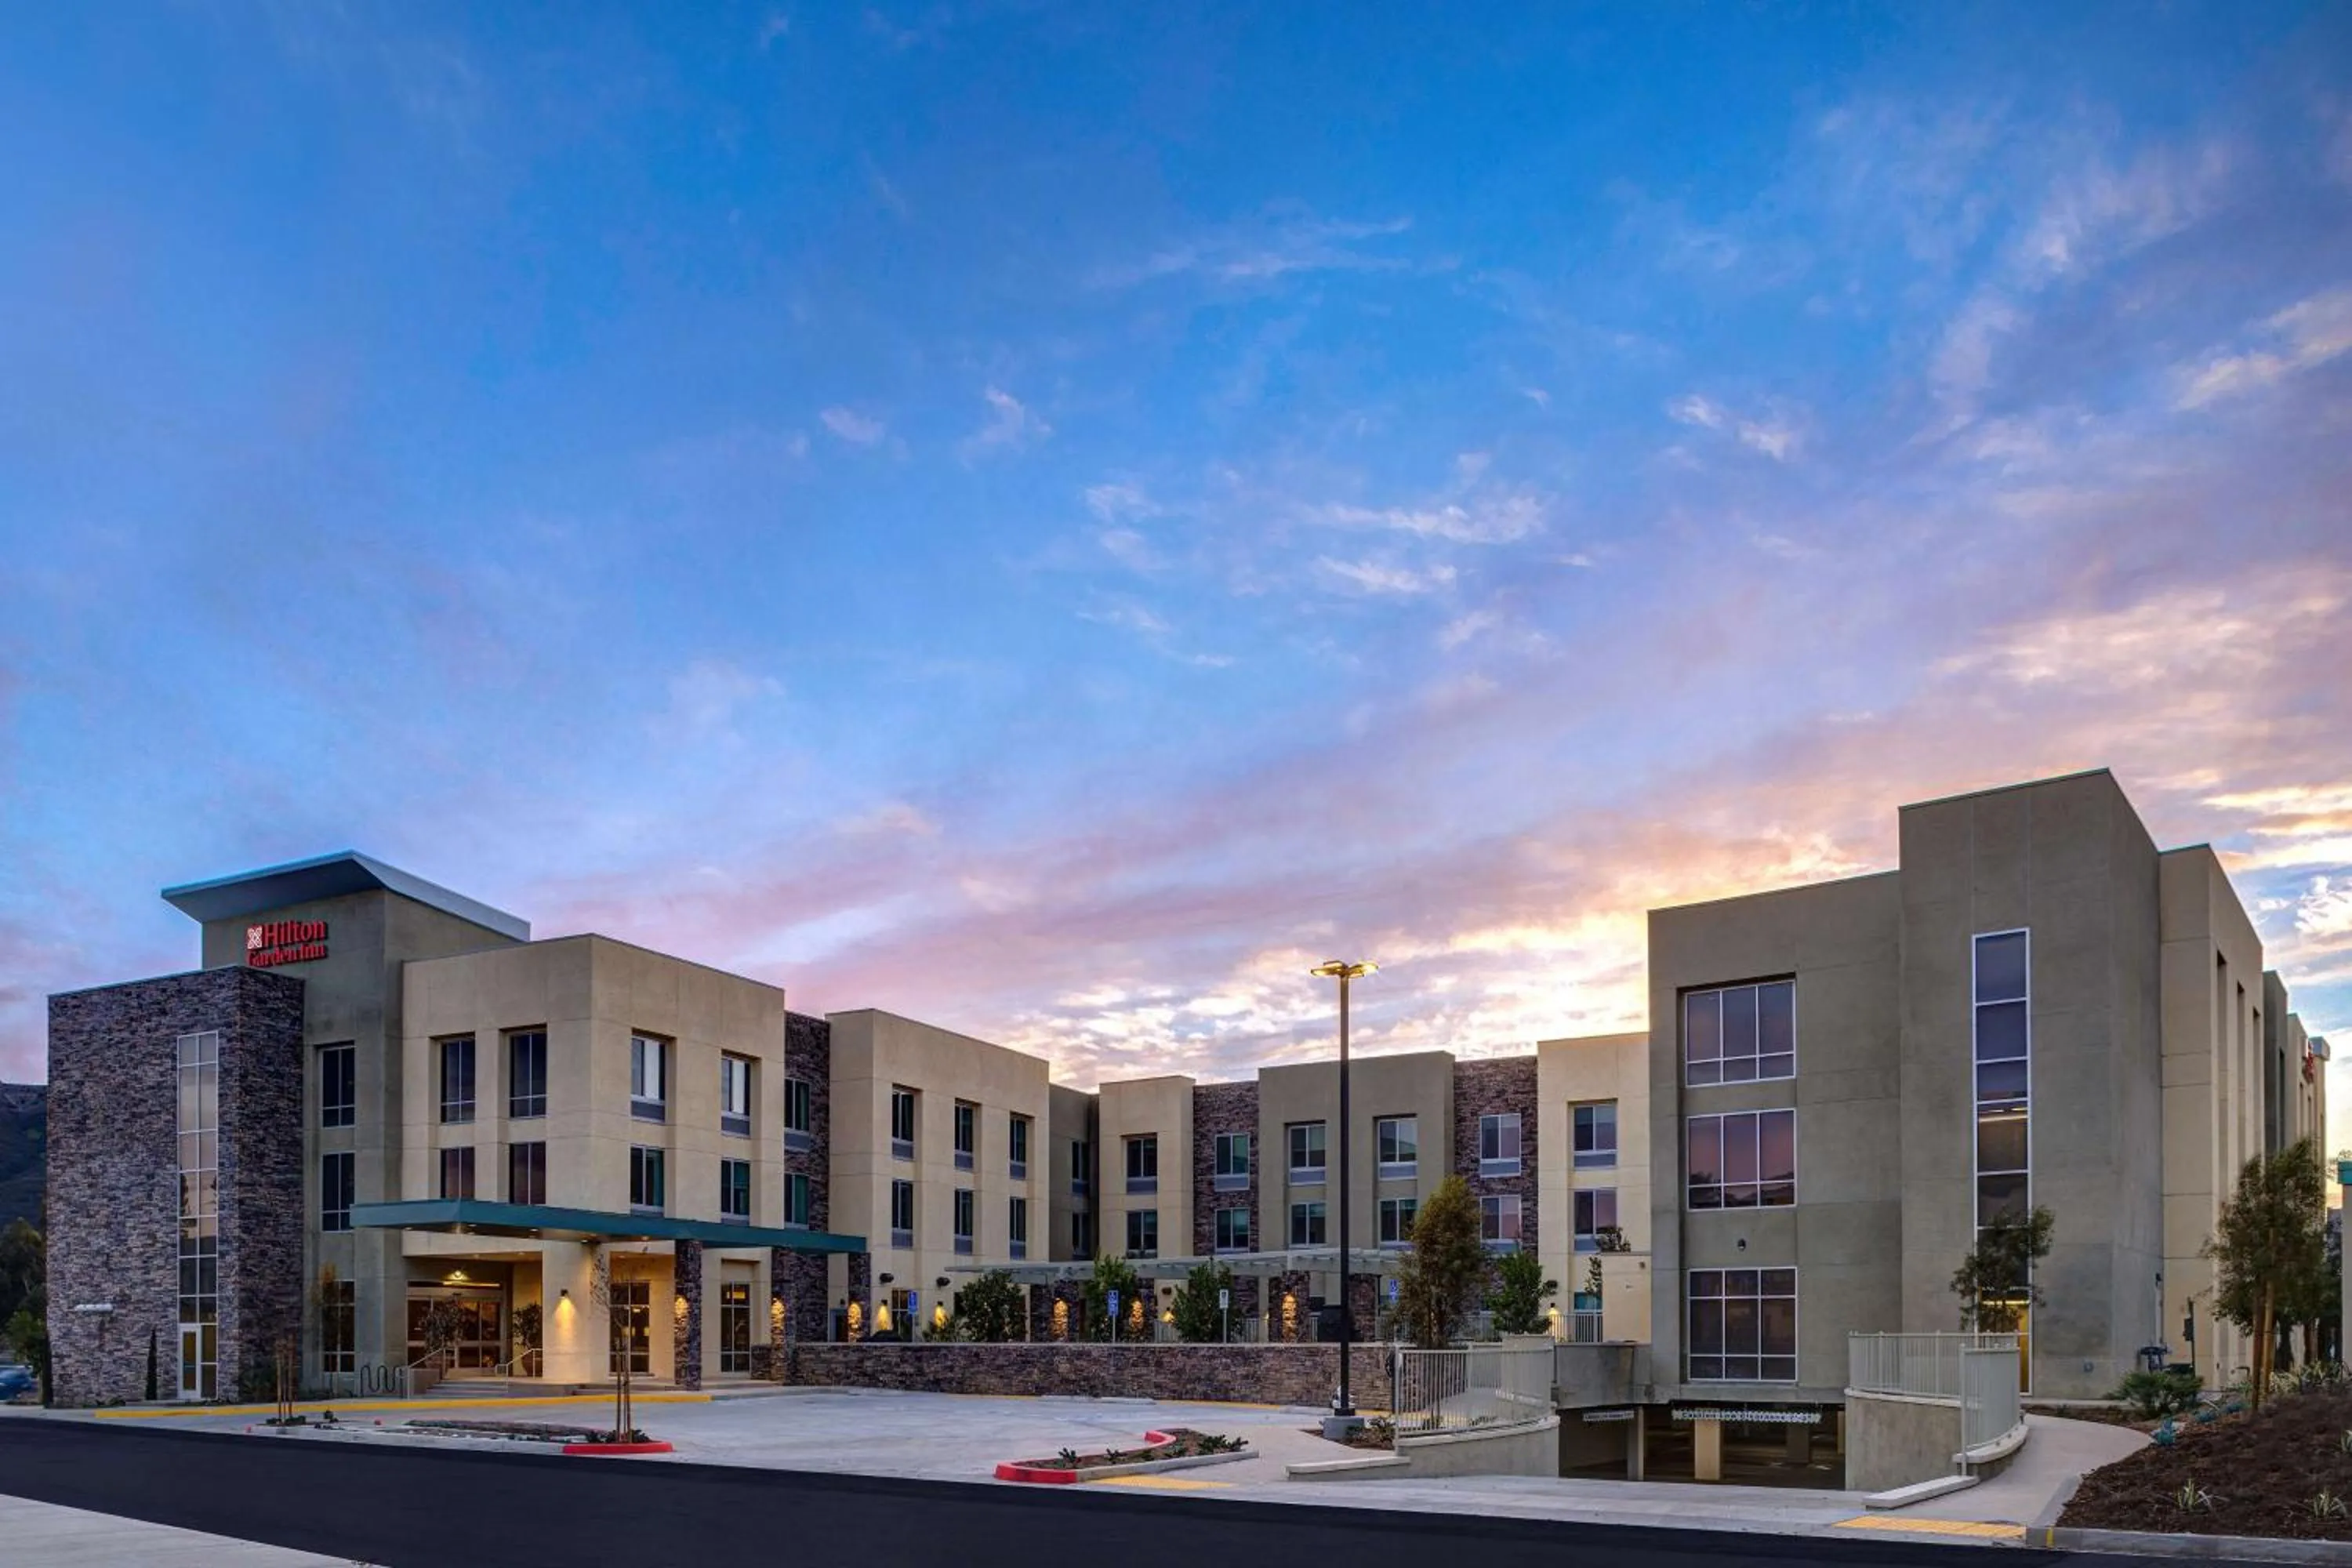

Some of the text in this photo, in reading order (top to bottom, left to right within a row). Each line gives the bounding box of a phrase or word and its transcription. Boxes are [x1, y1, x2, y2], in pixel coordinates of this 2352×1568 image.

[264, 920, 327, 947] Hilton
[246, 942, 327, 967] Garden Inn
